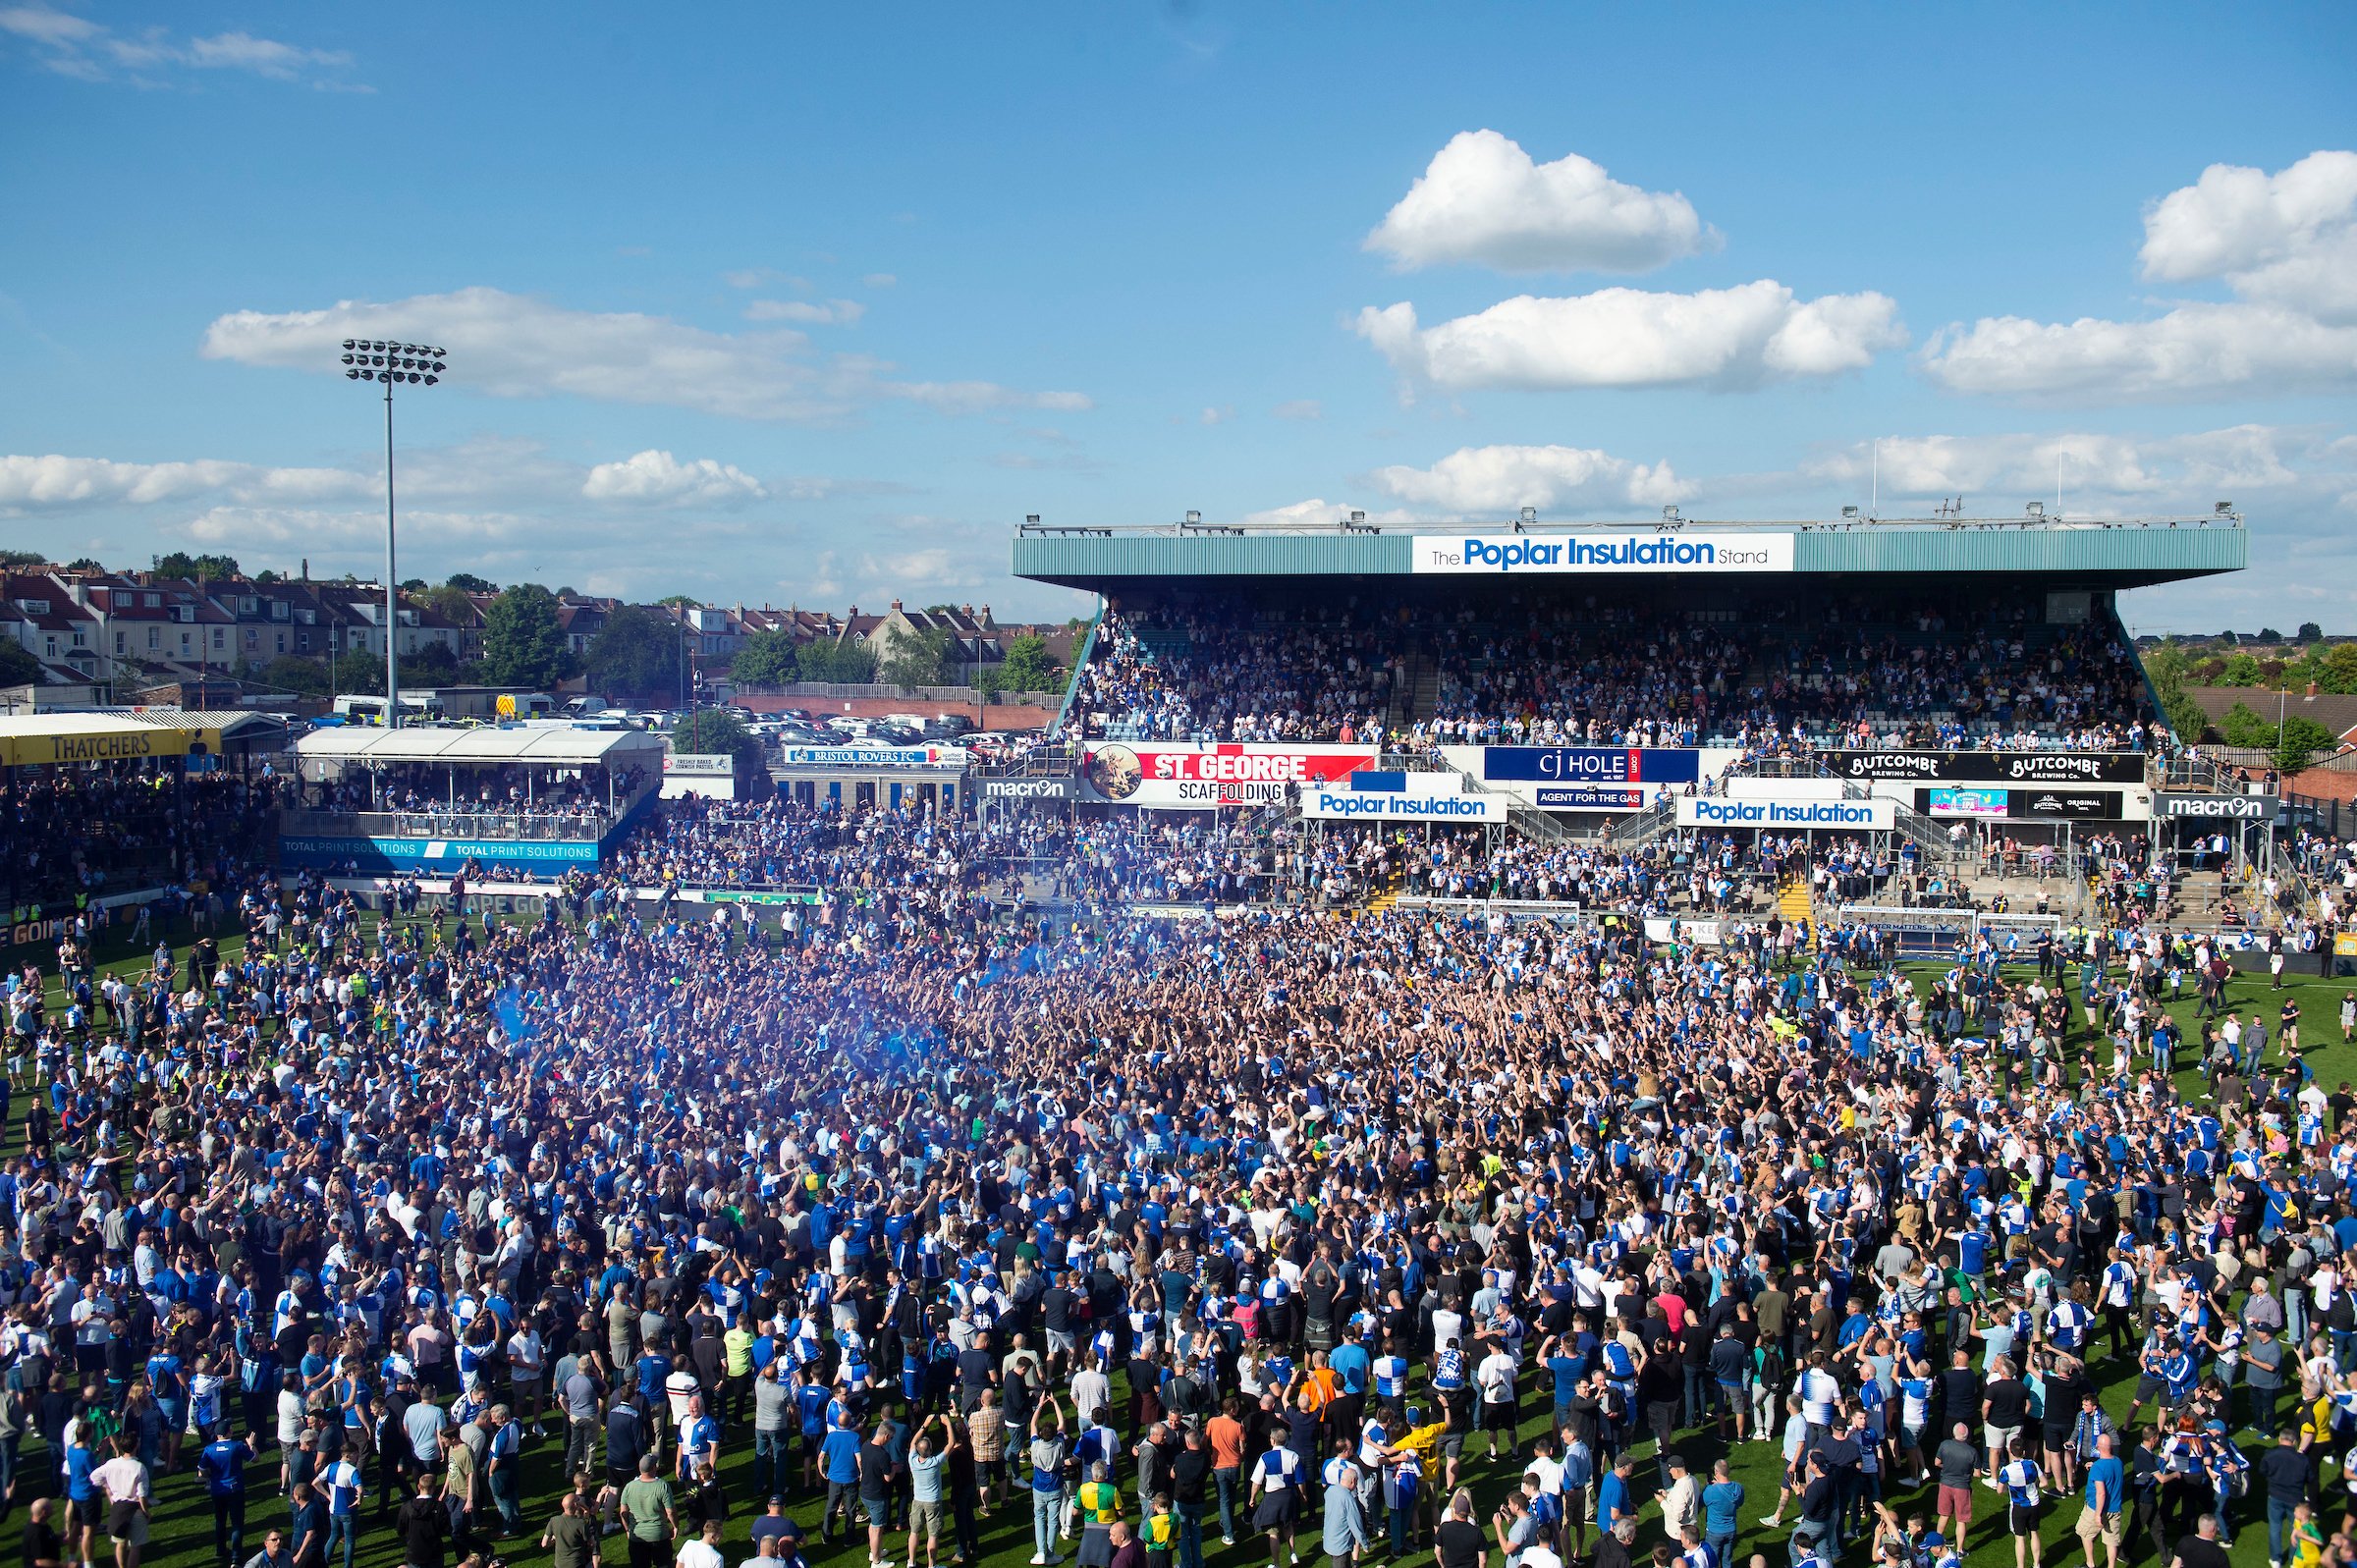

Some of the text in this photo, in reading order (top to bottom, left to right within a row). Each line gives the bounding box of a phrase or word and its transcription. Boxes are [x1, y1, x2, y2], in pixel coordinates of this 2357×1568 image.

[1432, 537, 1768, 570] The Poplar Insulation Stand
[51, 732, 150, 759] THATCHERS
[814, 751, 914, 762] BRISTOL ROVERS FC
[1570, 756, 1624, 773] HOLE
[1155, 755, 1306, 781] ST. GEORGE
[1849, 755, 1939, 778] BUTCOMBE
[2009, 755, 2102, 779] BUTCOMBE
[986, 780, 1064, 798] macron
[1178, 783, 1282, 800] SCAFFOLDING
[1540, 793, 1573, 803] AGENT
[1576, 793, 1596, 802] FOR
[1619, 794, 1640, 803] GAS
[1320, 794, 1485, 816] Poplar Insulation
[1695, 801, 1872, 824] Poplar Insulation
[2168, 797, 2263, 816] macron
[285, 841, 316, 852] TOTAL
[318, 842, 351, 853] PRINT
[353, 843, 416, 855] SOLUTIONS
[456, 845, 489, 856] TOTAL
[491, 846, 524, 856] PRINT
[527, 846, 591, 858] SOLUTIONS
